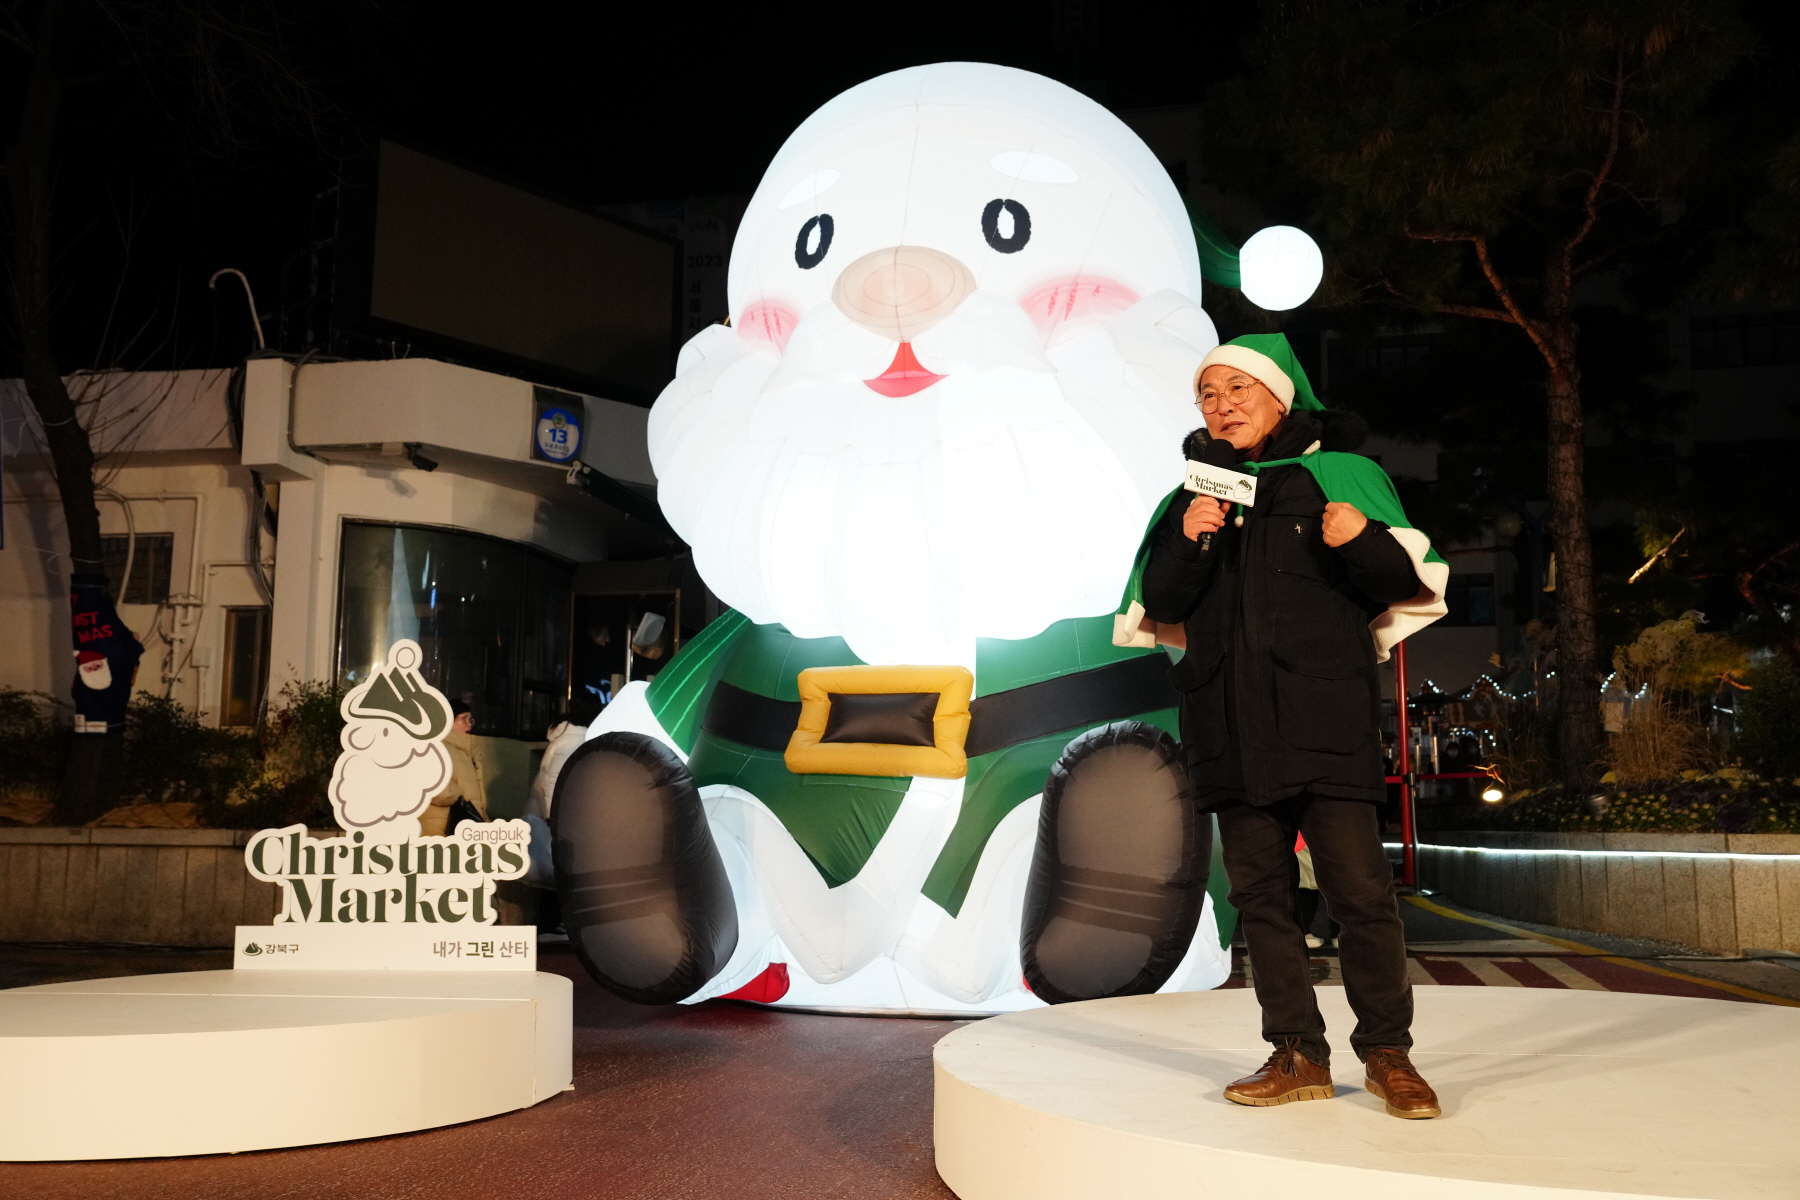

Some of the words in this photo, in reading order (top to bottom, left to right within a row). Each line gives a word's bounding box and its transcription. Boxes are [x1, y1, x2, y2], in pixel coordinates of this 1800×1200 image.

[688, 254, 723, 268] 2023
[549, 428, 568, 444] 13
[1189, 474, 1234, 490] Christmas
[1194, 481, 1227, 495] Market
[77, 624, 114, 643] MAS
[461, 826, 524, 844] Gangbuk
[251, 830, 524, 875] Christmas
[281, 873, 490, 923] Market
[265, 943, 300, 955] 강북구
[433, 941, 462, 958] 내가
[465, 941, 495, 958] 그린
[499, 940, 529, 958] 산타
